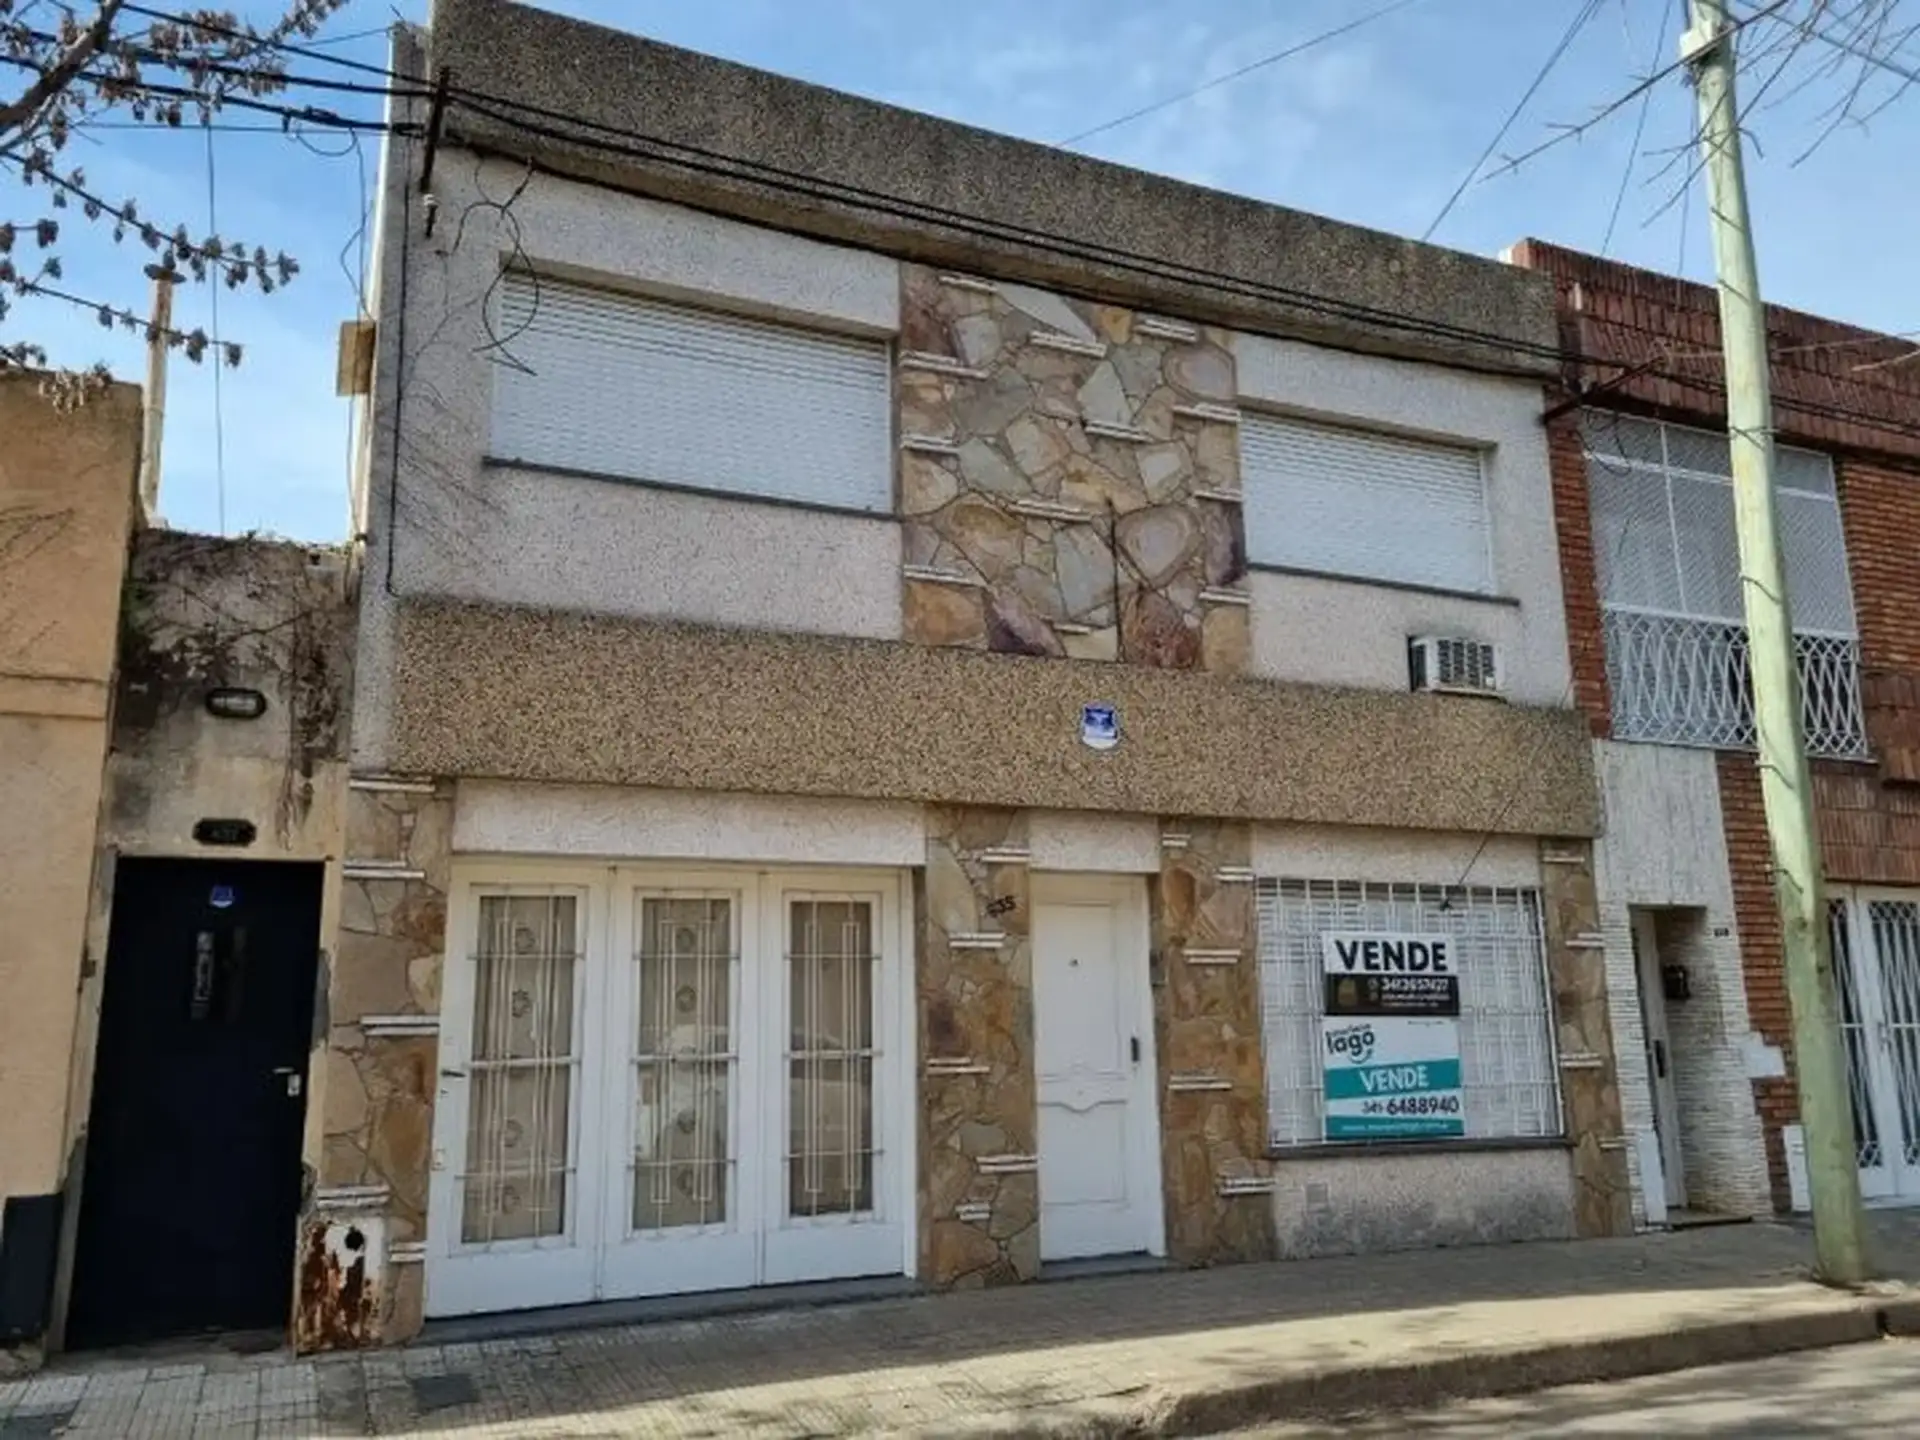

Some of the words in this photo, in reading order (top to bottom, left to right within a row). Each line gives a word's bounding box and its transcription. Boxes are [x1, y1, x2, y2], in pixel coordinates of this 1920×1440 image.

[1335, 939, 1448, 972] VENDE
[1325, 1030, 1375, 1057] lago
[1360, 1065, 1429, 1093] VENDE
[1386, 1095, 1460, 1115] 6488940
